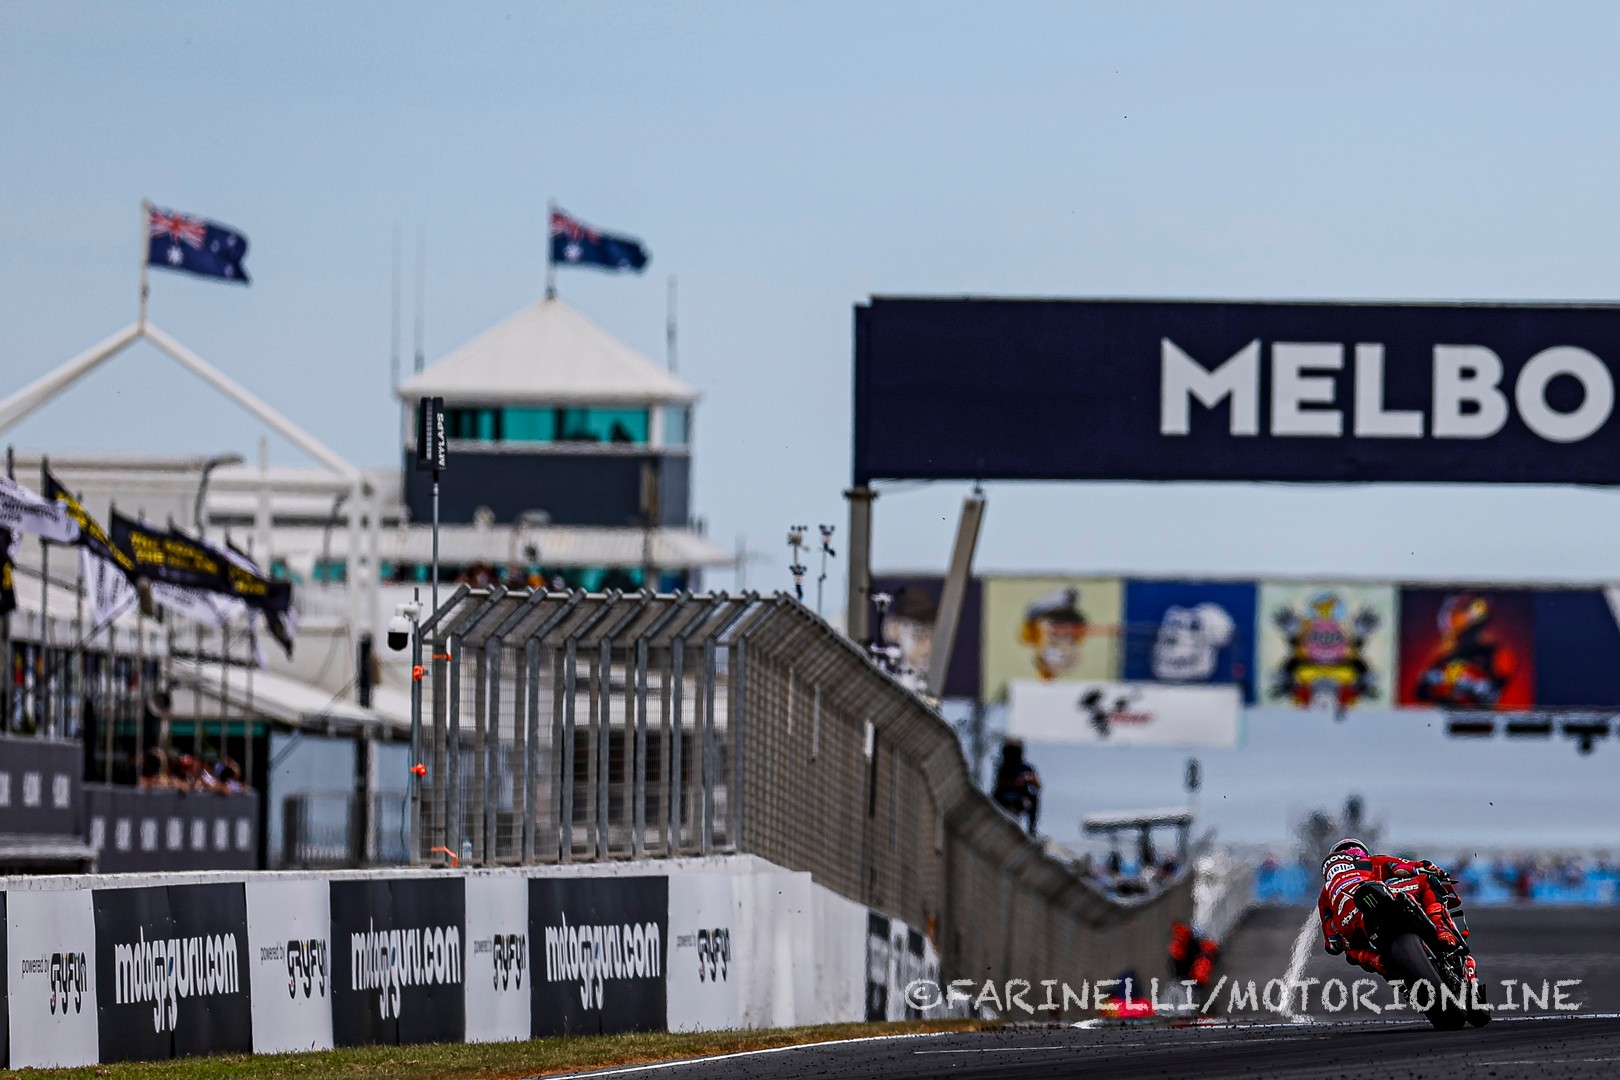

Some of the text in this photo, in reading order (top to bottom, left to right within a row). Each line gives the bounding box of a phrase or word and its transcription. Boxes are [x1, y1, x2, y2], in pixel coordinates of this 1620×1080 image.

[437, 412, 445, 467] MYLAPS
[1160, 338, 1615, 443] MELBO
[22, 953, 44, 979] powered
[115, 925, 239, 1033] motogpguru.com
[351, 916, 462, 1020] motogpguru.com
[545, 910, 660, 1011] motogpguru.com
